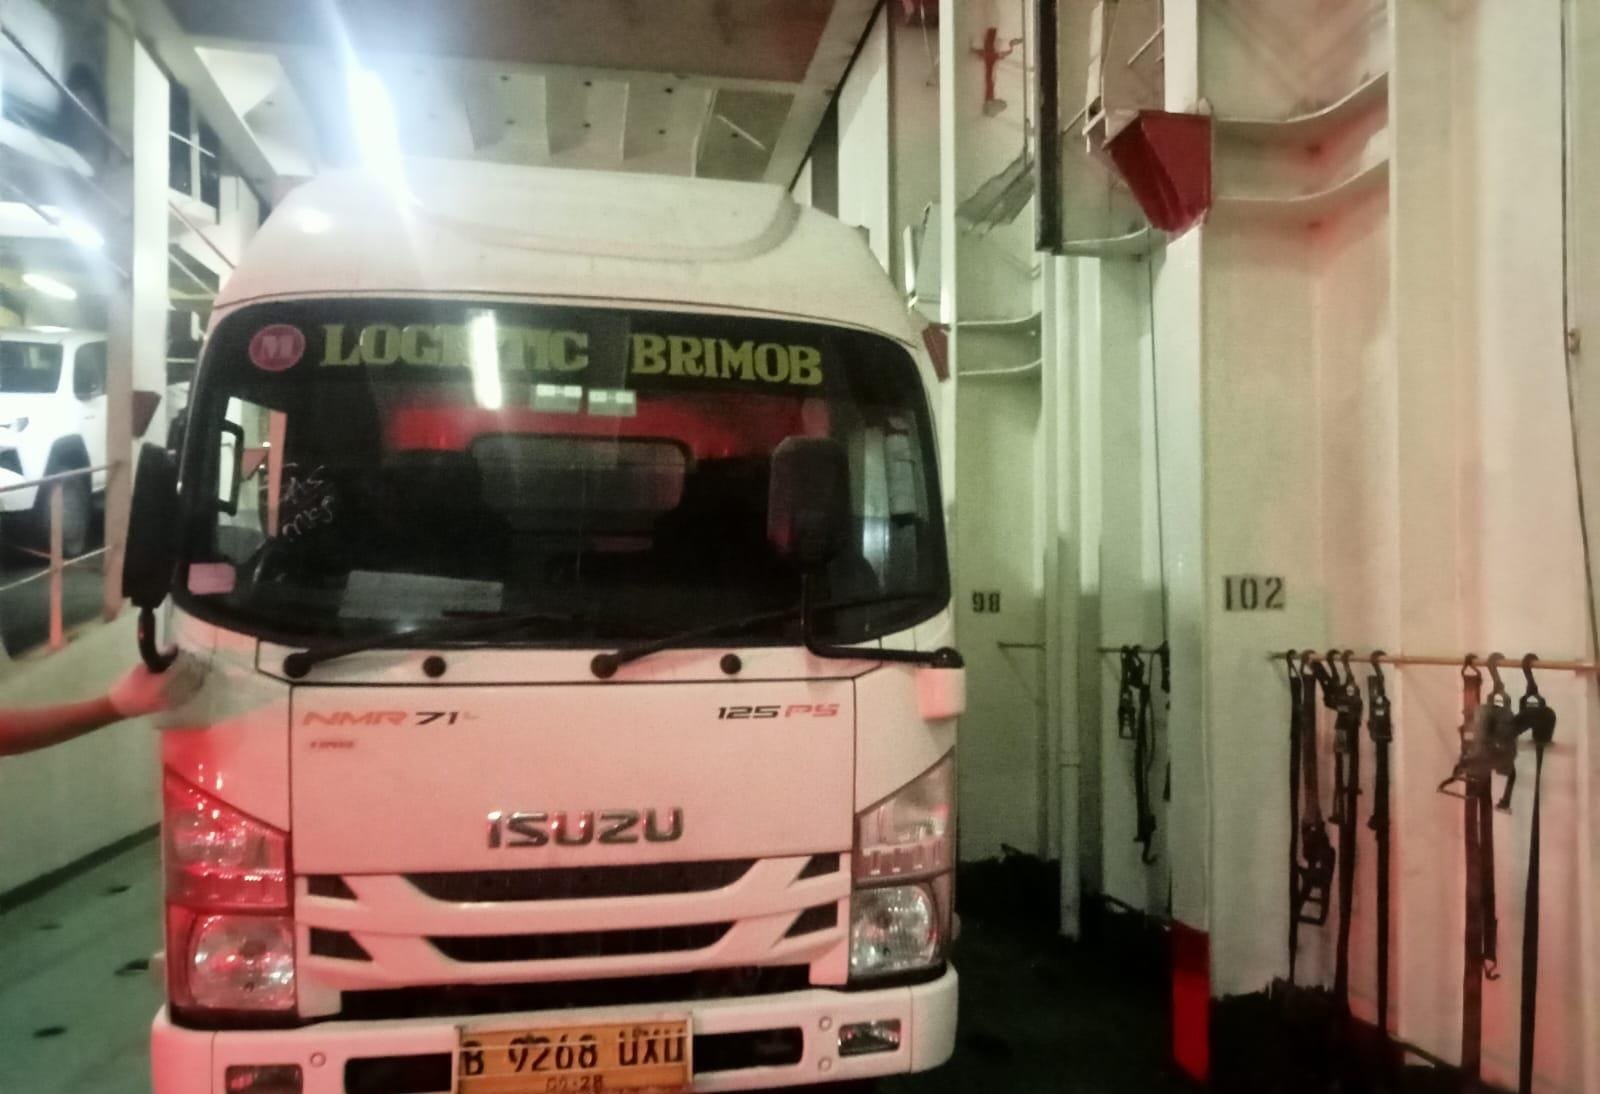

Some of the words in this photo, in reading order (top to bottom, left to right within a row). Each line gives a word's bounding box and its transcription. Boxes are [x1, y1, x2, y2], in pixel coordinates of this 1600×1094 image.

[319, 323, 589, 371] LOGITIC
[632, 333, 823, 386] BRIMOB
[972, 592, 1001, 613] 98
[1224, 576, 1285, 611] 102
[302, 711, 407, 726] NMR
[718, 705, 781, 720] 125
[784, 703, 840, 718] PS
[487, 807, 684, 849] ISUZU
[462, 1040, 485, 1076] B
[508, 1033, 598, 1072] 9268
